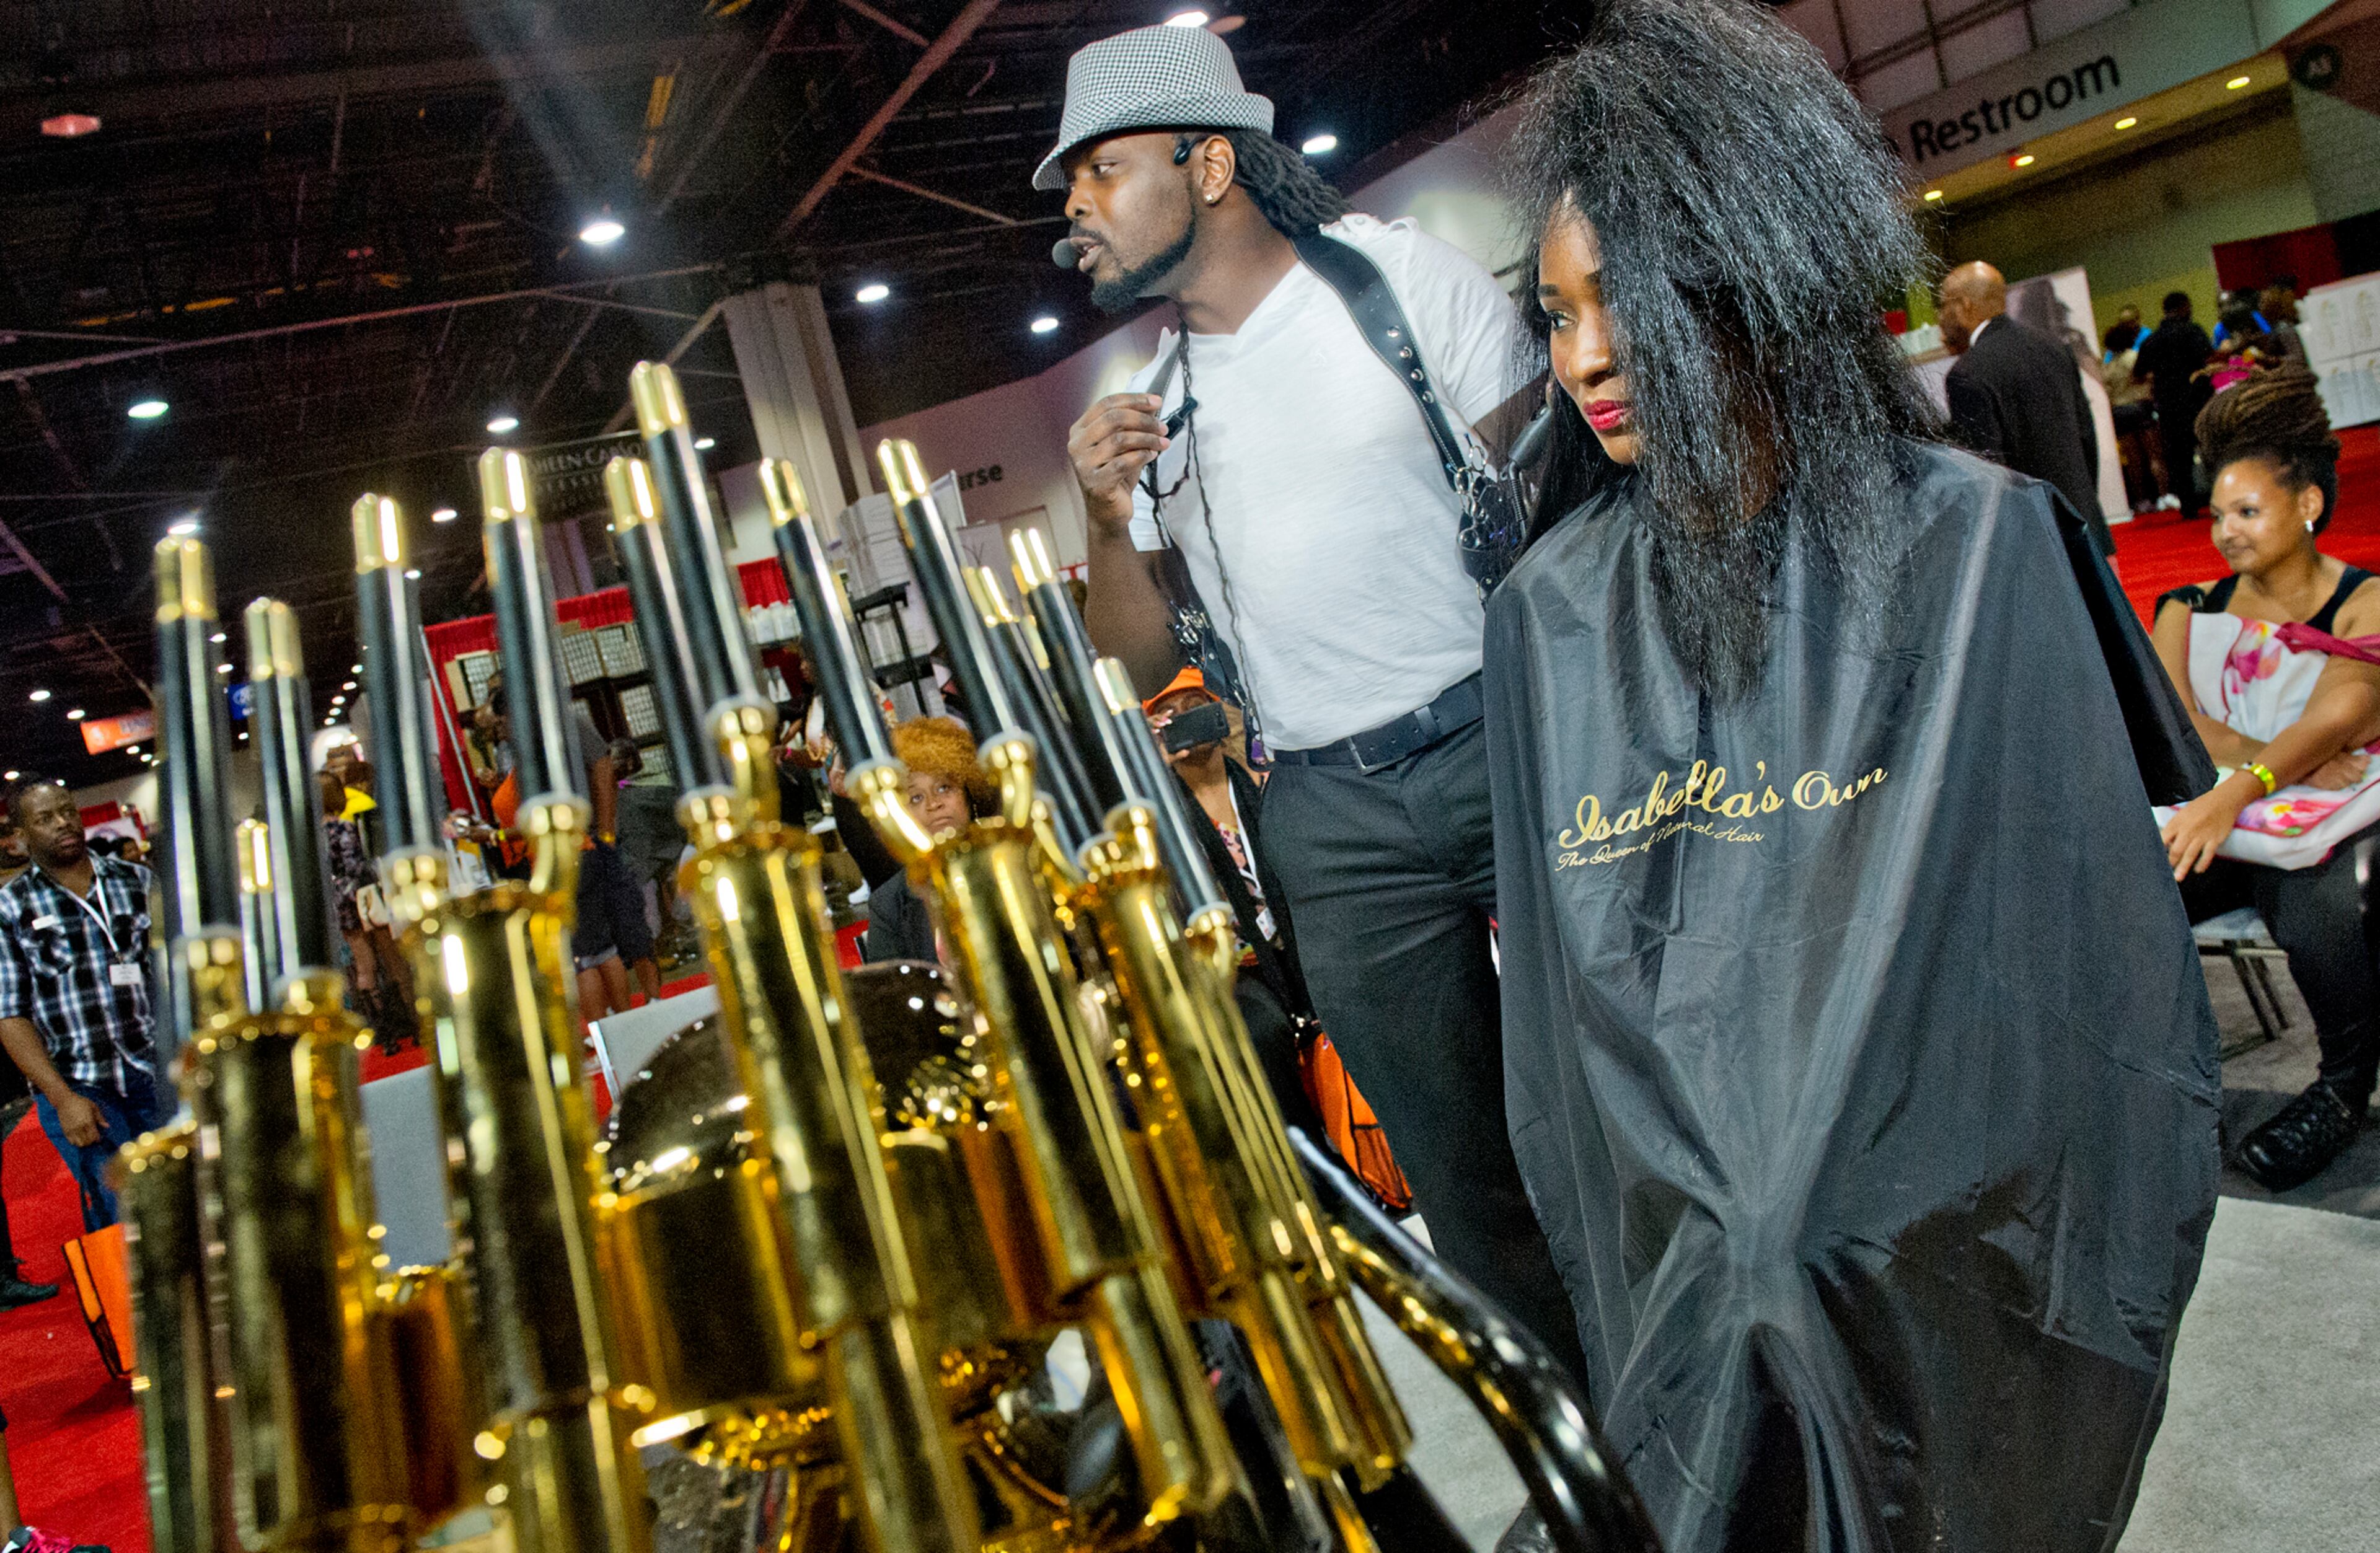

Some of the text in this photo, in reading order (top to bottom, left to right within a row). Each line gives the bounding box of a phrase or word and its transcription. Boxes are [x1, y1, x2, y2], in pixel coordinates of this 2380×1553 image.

[1909, 55, 2121, 163] Restroom
[1555, 820, 1765, 871] The Queen of Natural Hair
[1558, 759, 1888, 849] Isabella's Own
